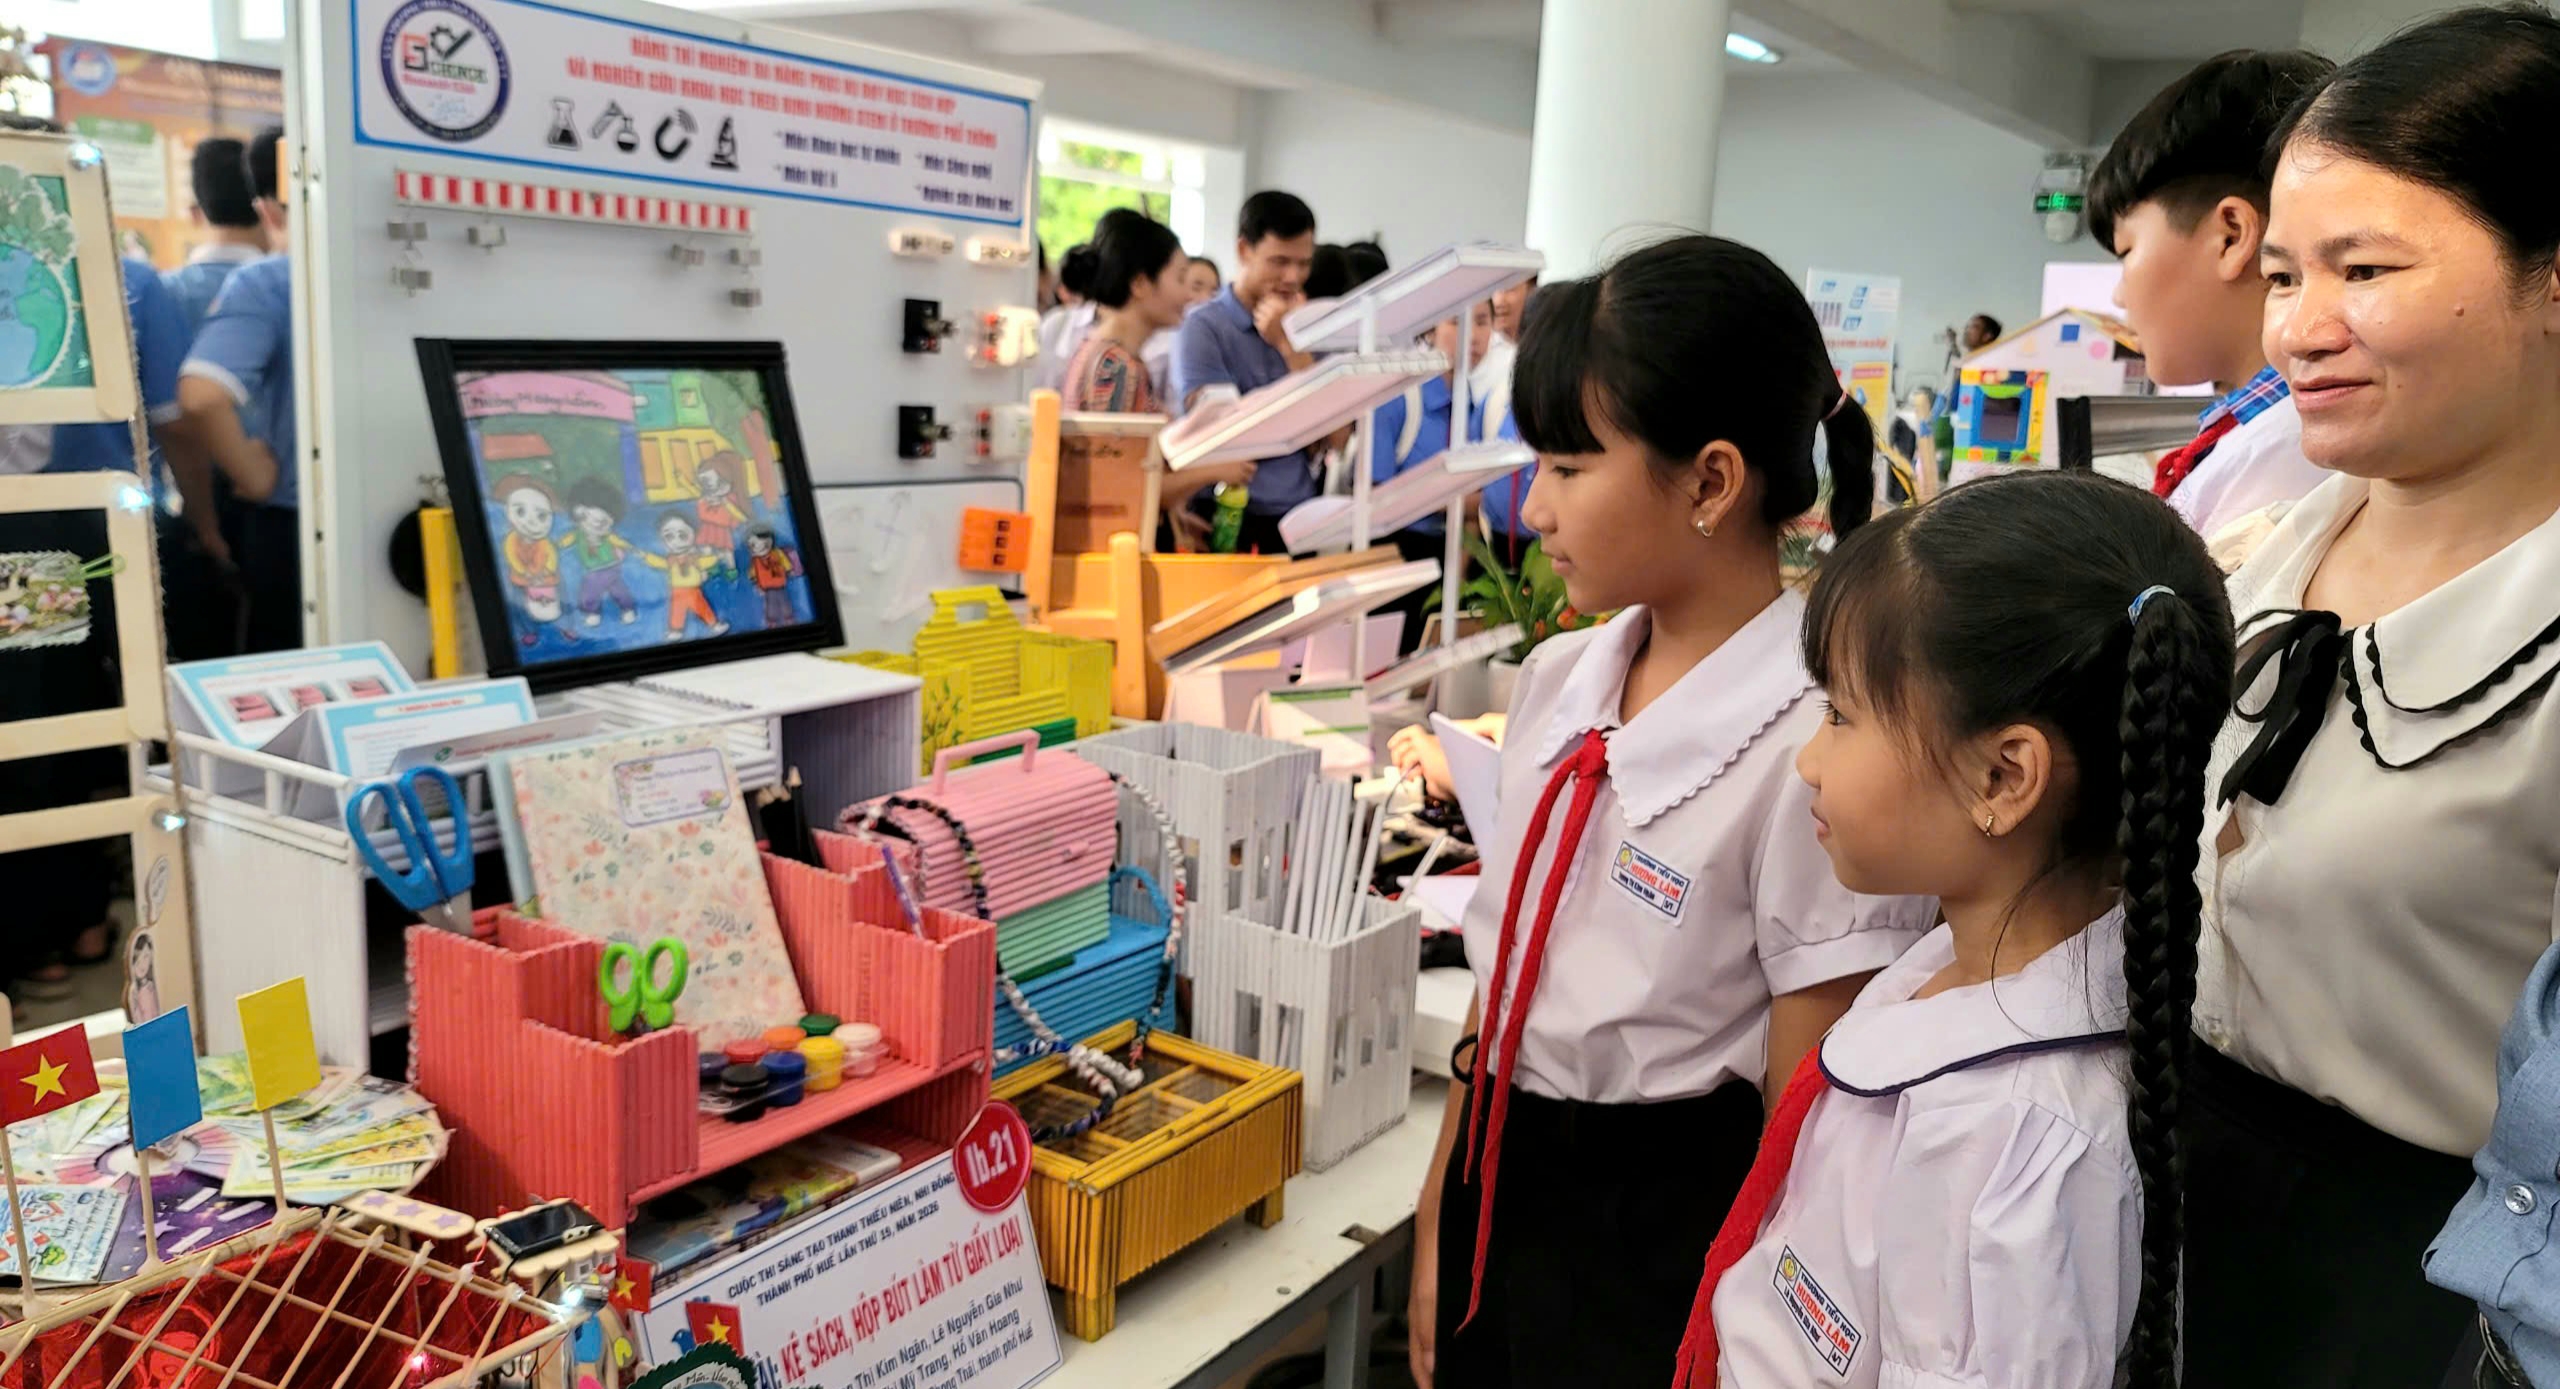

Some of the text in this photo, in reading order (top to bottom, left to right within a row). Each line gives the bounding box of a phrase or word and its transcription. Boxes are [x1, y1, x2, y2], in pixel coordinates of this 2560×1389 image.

[728, 1275, 757, 1299] CUỘC
[758, 1265, 776, 1282] THI
[778, 1250, 805, 1273] SÁNG
[805, 1239, 825, 1258] TẠO
[827, 1221, 859, 1246] THANH
[859, 1206, 888, 1230] THIẾU
[914, 1187, 930, 1201] NHI
[931, 1171, 956, 1193] ĐỒNG
[757, 1279, 792, 1306] THÀNH
[794, 1261, 814, 1287] PHỐ
[816, 1249, 836, 1275] HUẾ
[839, 1240, 858, 1264] LẦN
[858, 1228, 878, 1252] THỨ
[896, 1211, 917, 1232] NĂM
[917, 1199, 939, 1221] 2026
[806, 1315, 854, 1369] SÁCH,
[851, 1291, 881, 1343] HỘP
[882, 1272, 913, 1324] BÚT
[912, 1258, 946, 1306] LÀM
[941, 1241, 964, 1287] TỪ
[963, 1220, 993, 1276] GIẤY
[992, 1213, 1024, 1259] LOẠI
[876, 1356, 899, 1379] Kim
[899, 1338, 932, 1365] Ngân,
[931, 1323, 945, 1345] Lê
[946, 1298, 985, 1335] Nguyễn
[985, 1290, 1003, 1311] Gia
[1003, 1275, 1023, 1300] Như
[1017, 1318, 1034, 1345] Huế
[1796, 1281, 1851, 1354] HƯƠNG LÂM
[1801, 1272, 1856, 1342] TRƯỜNG TIỂU HỌC
[952, 1335, 967, 1359] Hồ
